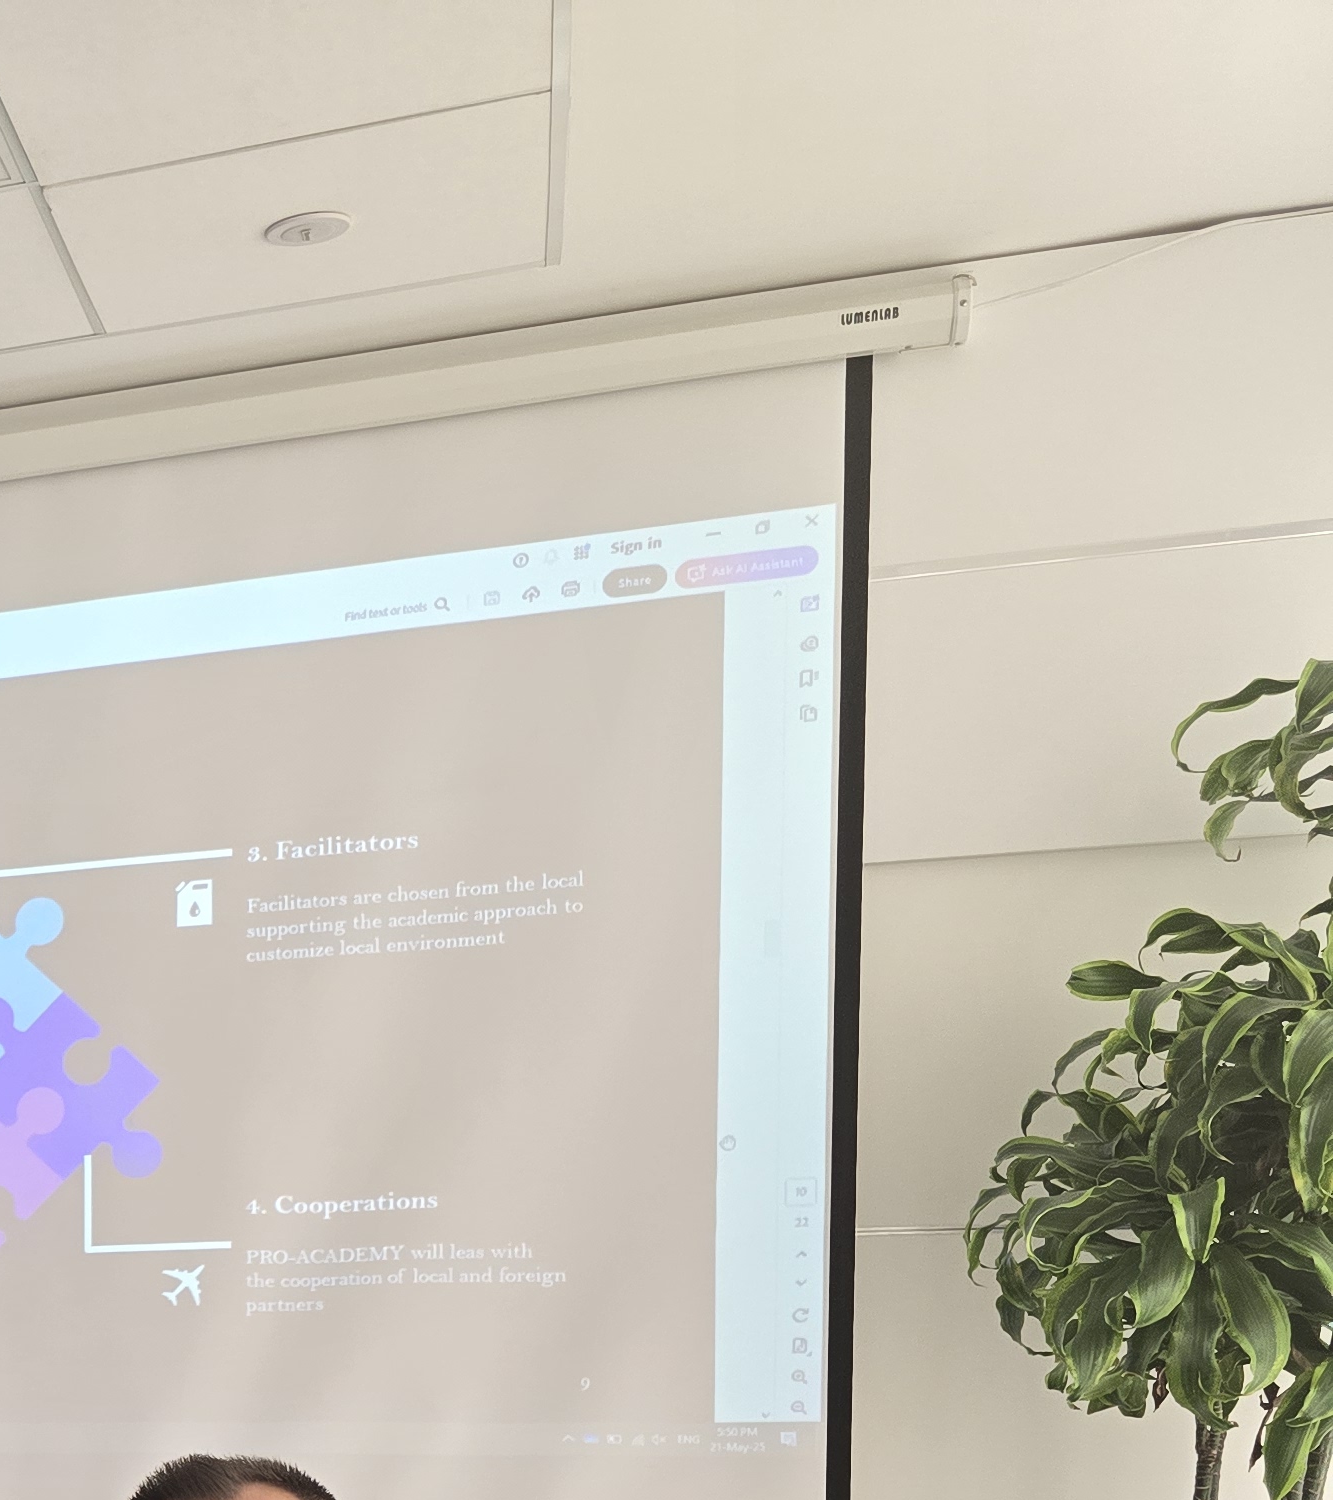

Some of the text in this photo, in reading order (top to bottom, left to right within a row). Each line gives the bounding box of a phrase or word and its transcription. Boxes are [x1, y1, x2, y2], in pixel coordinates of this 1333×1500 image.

[841, 307, 899, 325] LUMENLAB
[611, 536, 662, 556] Sign in
[712, 557, 804, 577] Ask AI Assistant
[618, 575, 652, 588] Share
[345, 601, 427, 622] Find text or tools
[247, 834, 419, 863] 3. Facilitators
[246, 870, 584, 914] Facilitators are chosen from the local
[246, 899, 583, 942] supporting the academic approach to
[246, 931, 505, 963] customize local environment
[795, 1187, 808, 1197] 10
[245, 1191, 438, 1219] 4. Cooperations
[246, 1242, 533, 1265] PRO-ACADEMY will leas with
[246, 1263, 566, 1292] the cooperation of local and foreign
[246, 1297, 324, 1316] partners
[580, 1377, 590, 1390] 9
[677, 1434, 700, 1444] ENG
[741, 1427, 758, 1437] PM
